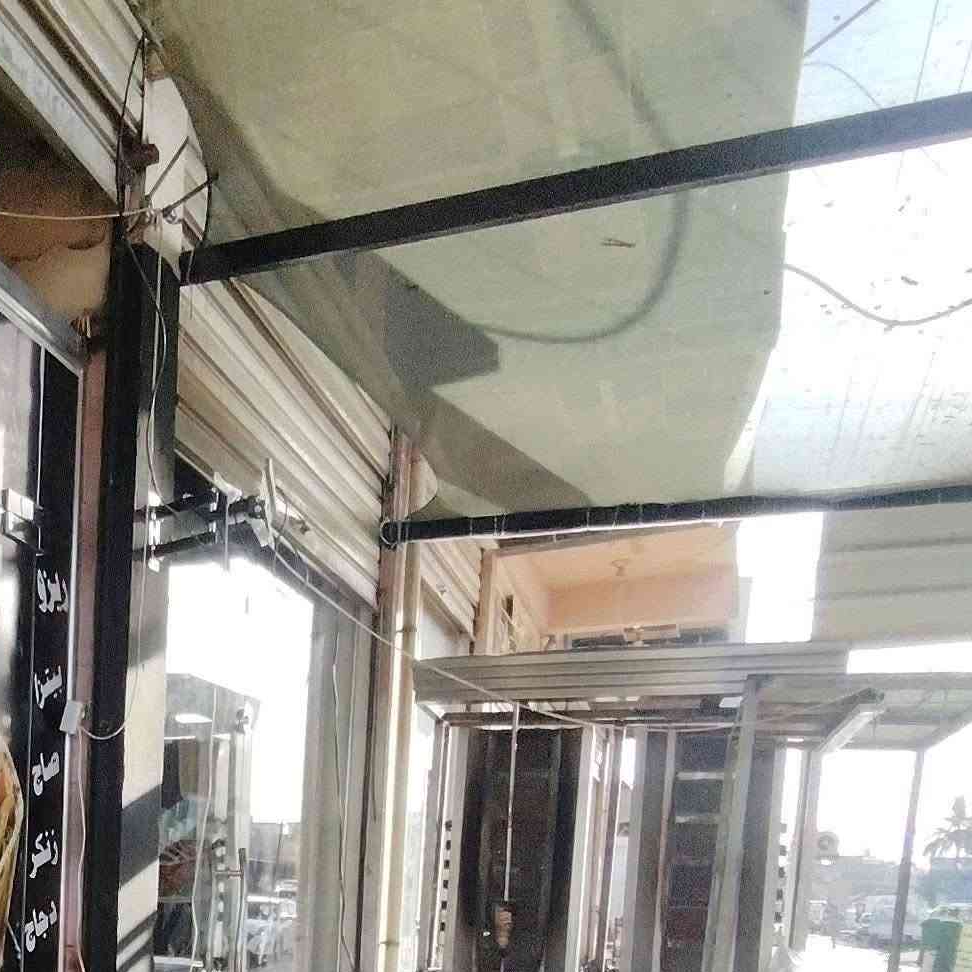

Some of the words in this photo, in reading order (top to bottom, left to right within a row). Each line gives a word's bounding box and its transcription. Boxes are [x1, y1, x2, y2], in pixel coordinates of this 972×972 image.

[34, 665, 64, 709] بيتزا
[31, 751, 61, 796] صاج
[24, 900, 58, 953] دجاج
